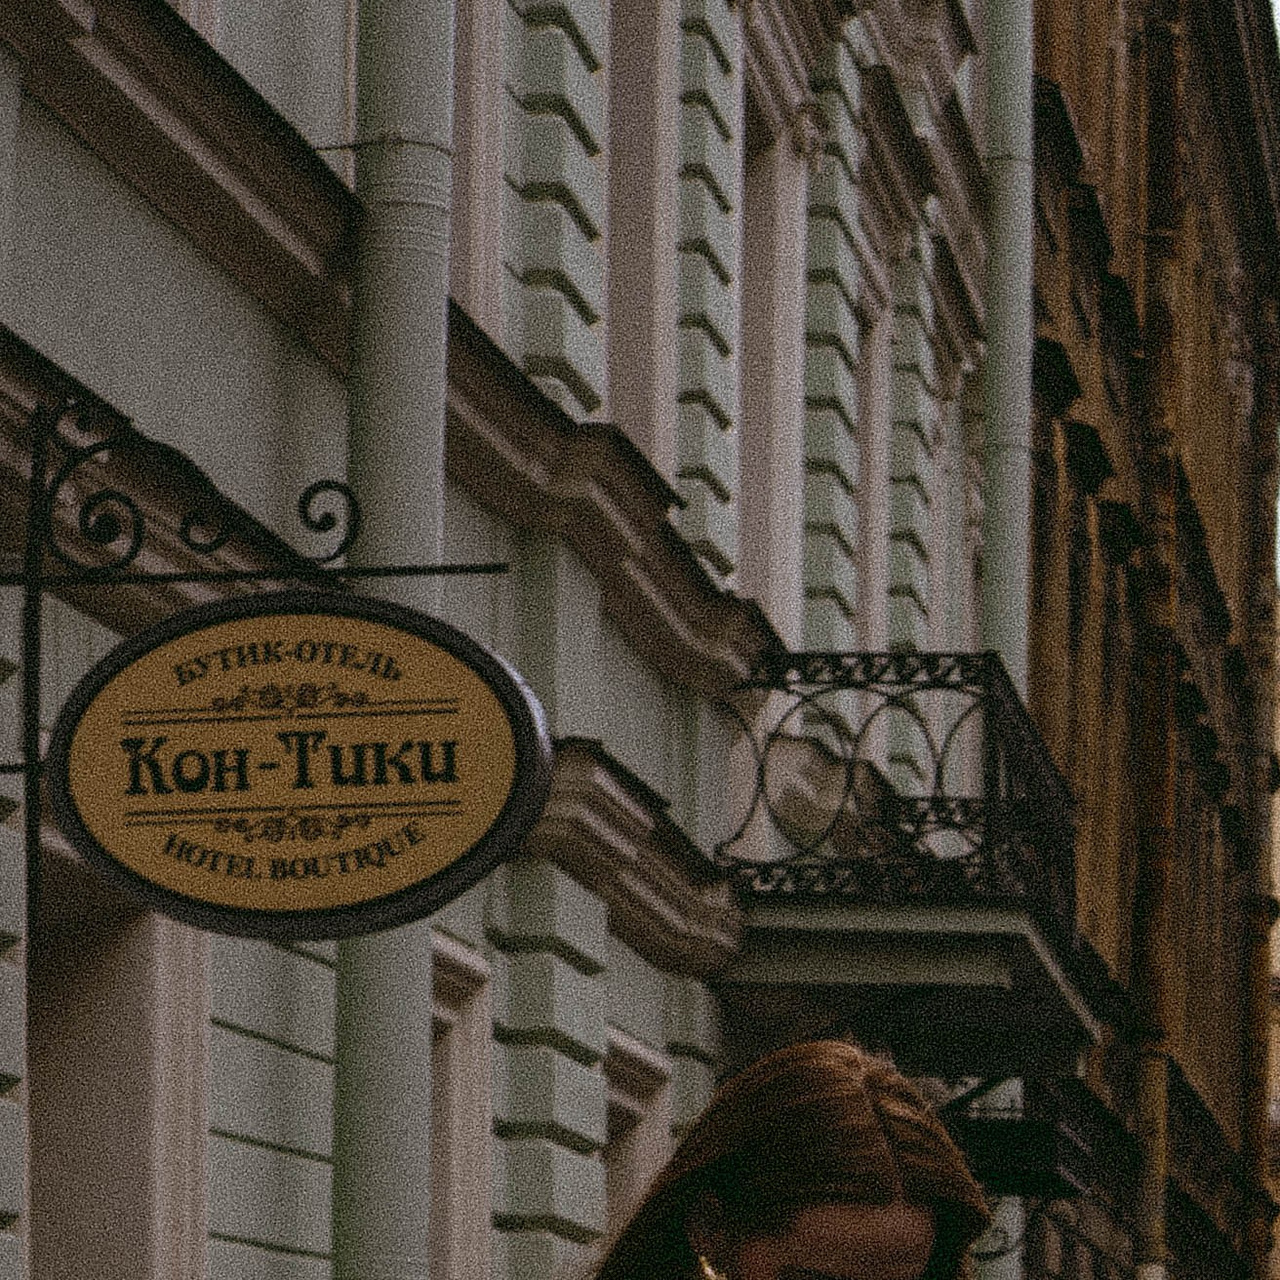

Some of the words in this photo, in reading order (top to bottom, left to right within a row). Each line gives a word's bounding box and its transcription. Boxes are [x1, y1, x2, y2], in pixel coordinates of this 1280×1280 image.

[174, 639, 401, 687] БУТИК-ОТЕЛЬ
[119, 731, 459, 796] Кон-Тики
[163, 832, 263, 880] HOTEL
[269, 822, 425, 881] BOUTIQUE
